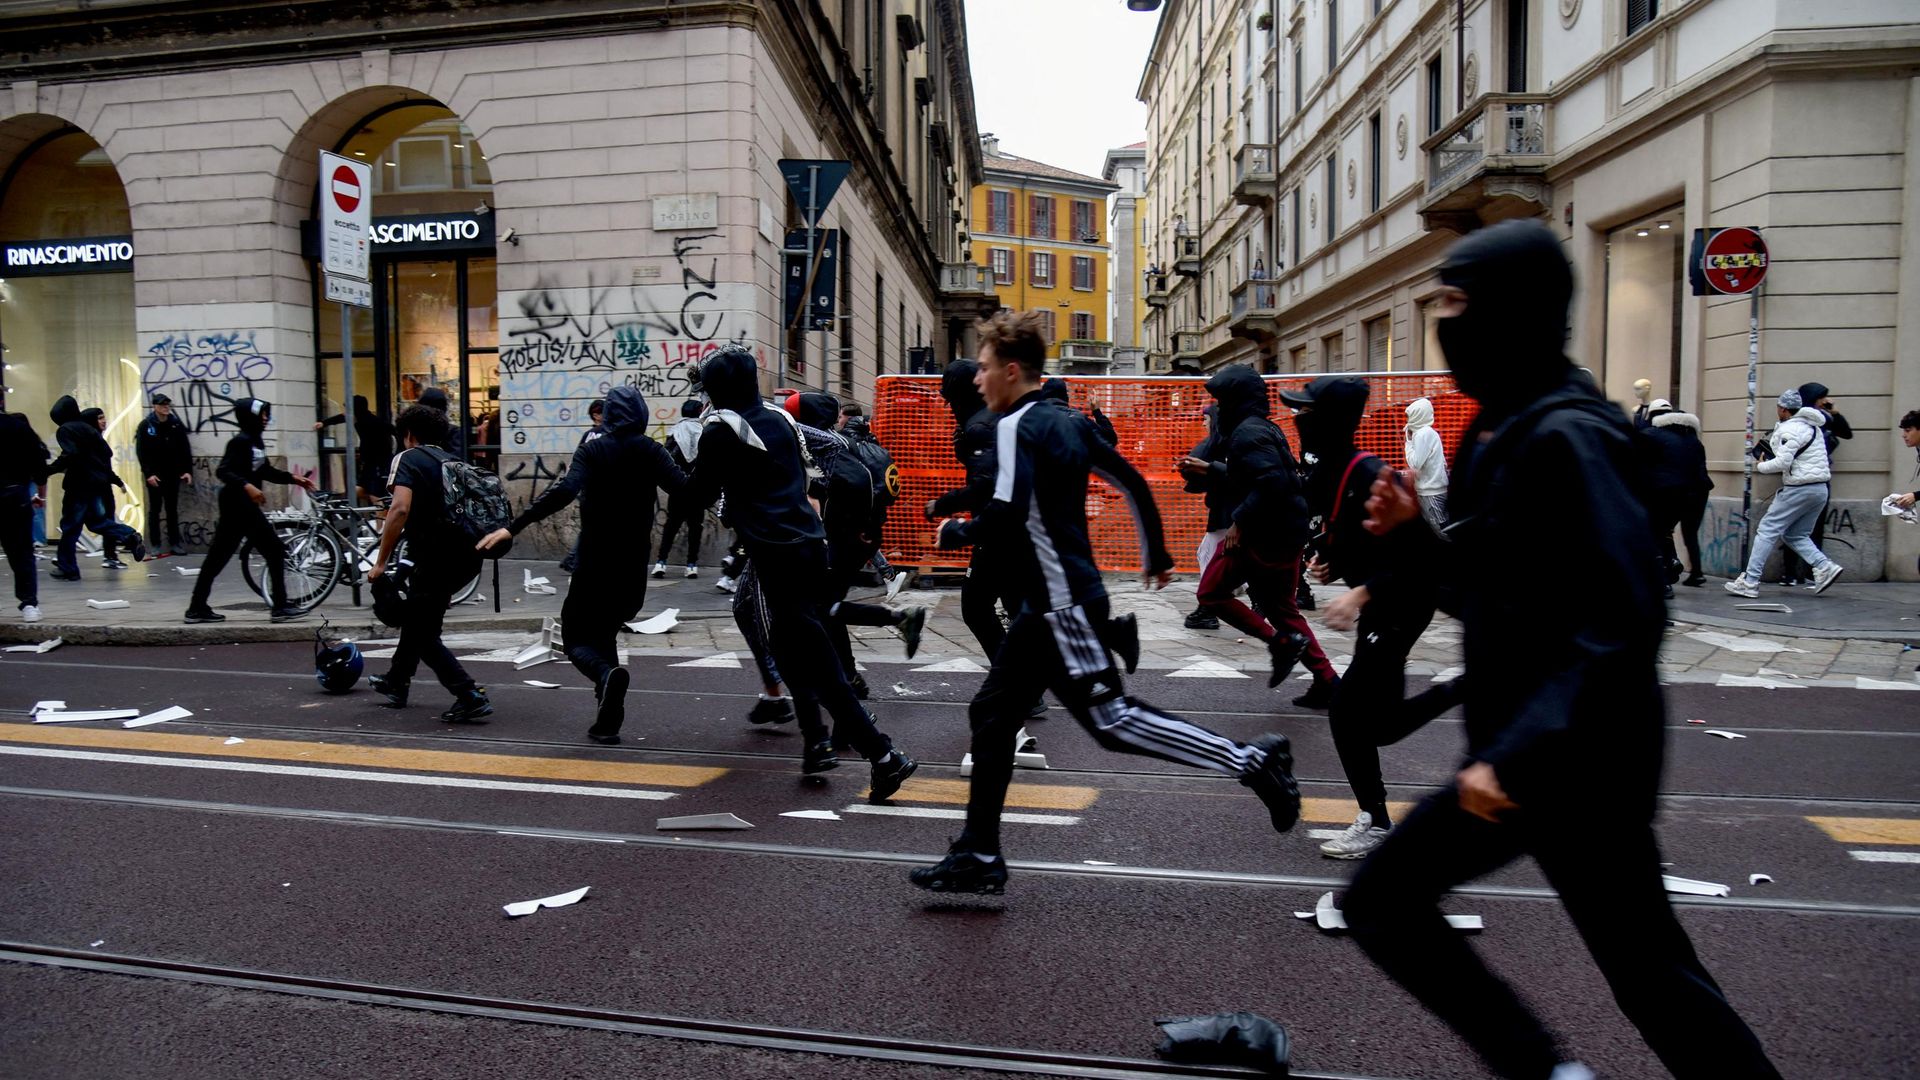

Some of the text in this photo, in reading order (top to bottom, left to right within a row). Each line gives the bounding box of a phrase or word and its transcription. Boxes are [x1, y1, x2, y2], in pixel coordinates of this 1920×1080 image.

[661, 211, 710, 222] TORINO
[368, 219, 479, 244] ASCIMENTO
[7, 242, 133, 266] RINASCIMENTO
